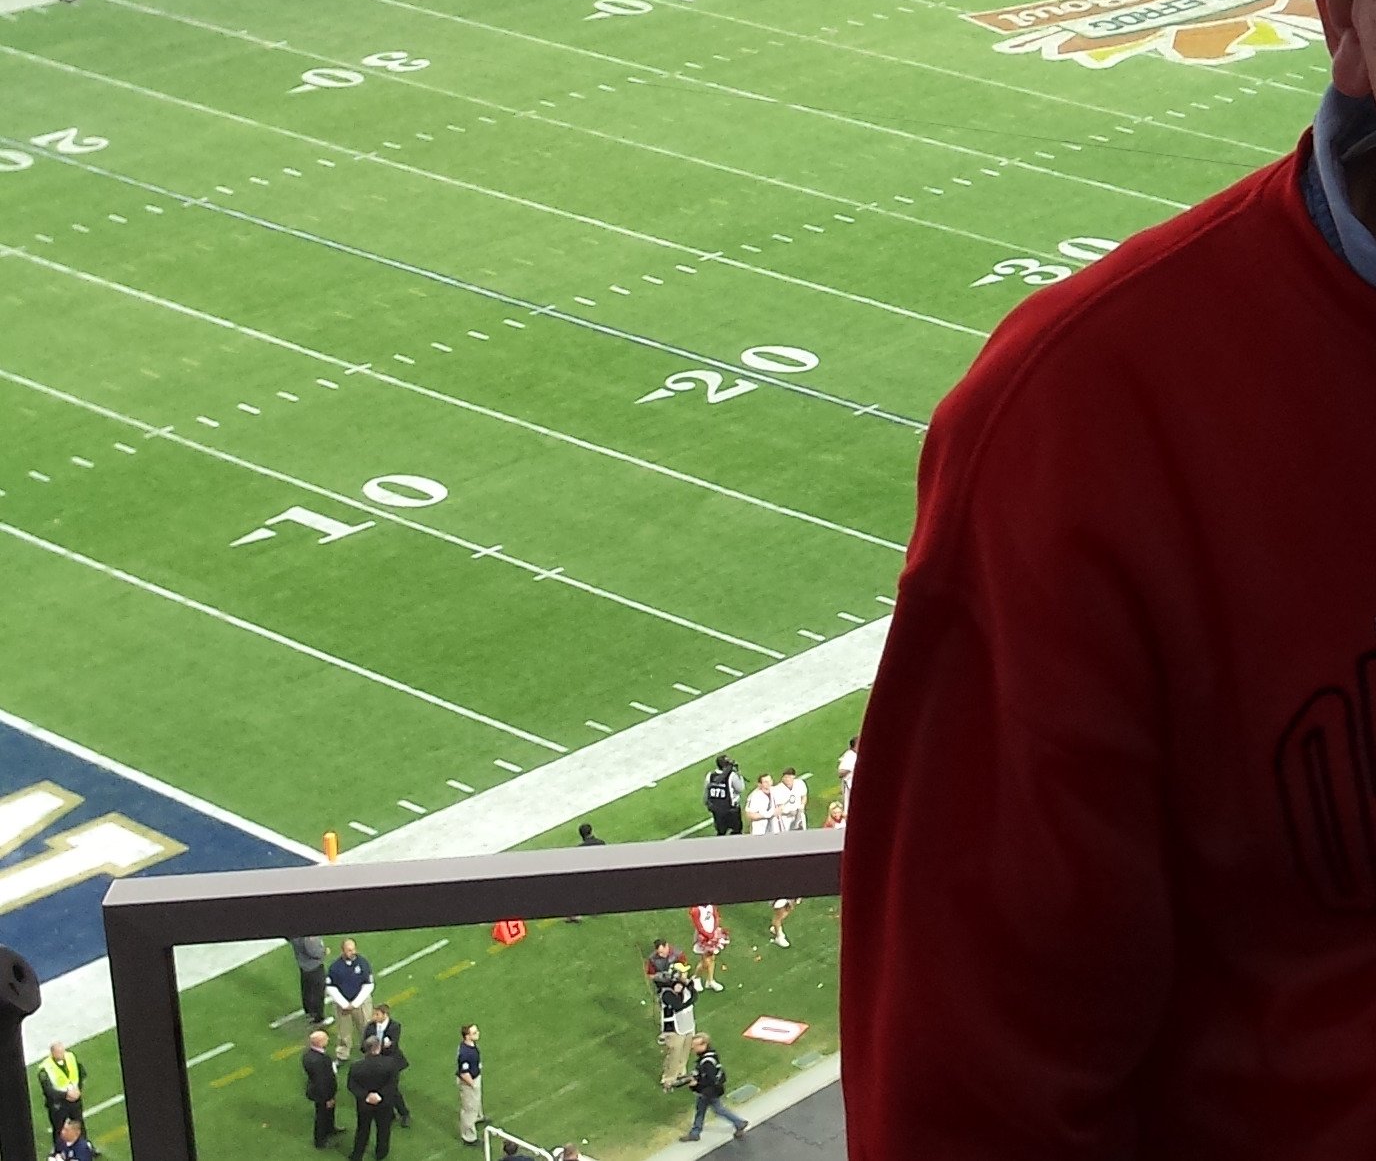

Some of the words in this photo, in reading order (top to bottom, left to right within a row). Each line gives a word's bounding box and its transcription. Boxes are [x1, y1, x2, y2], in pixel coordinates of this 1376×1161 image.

[301, 50, 431, 89] 30
[664, 344, 822, 405] 20
[269, 473, 450, 546] 10
